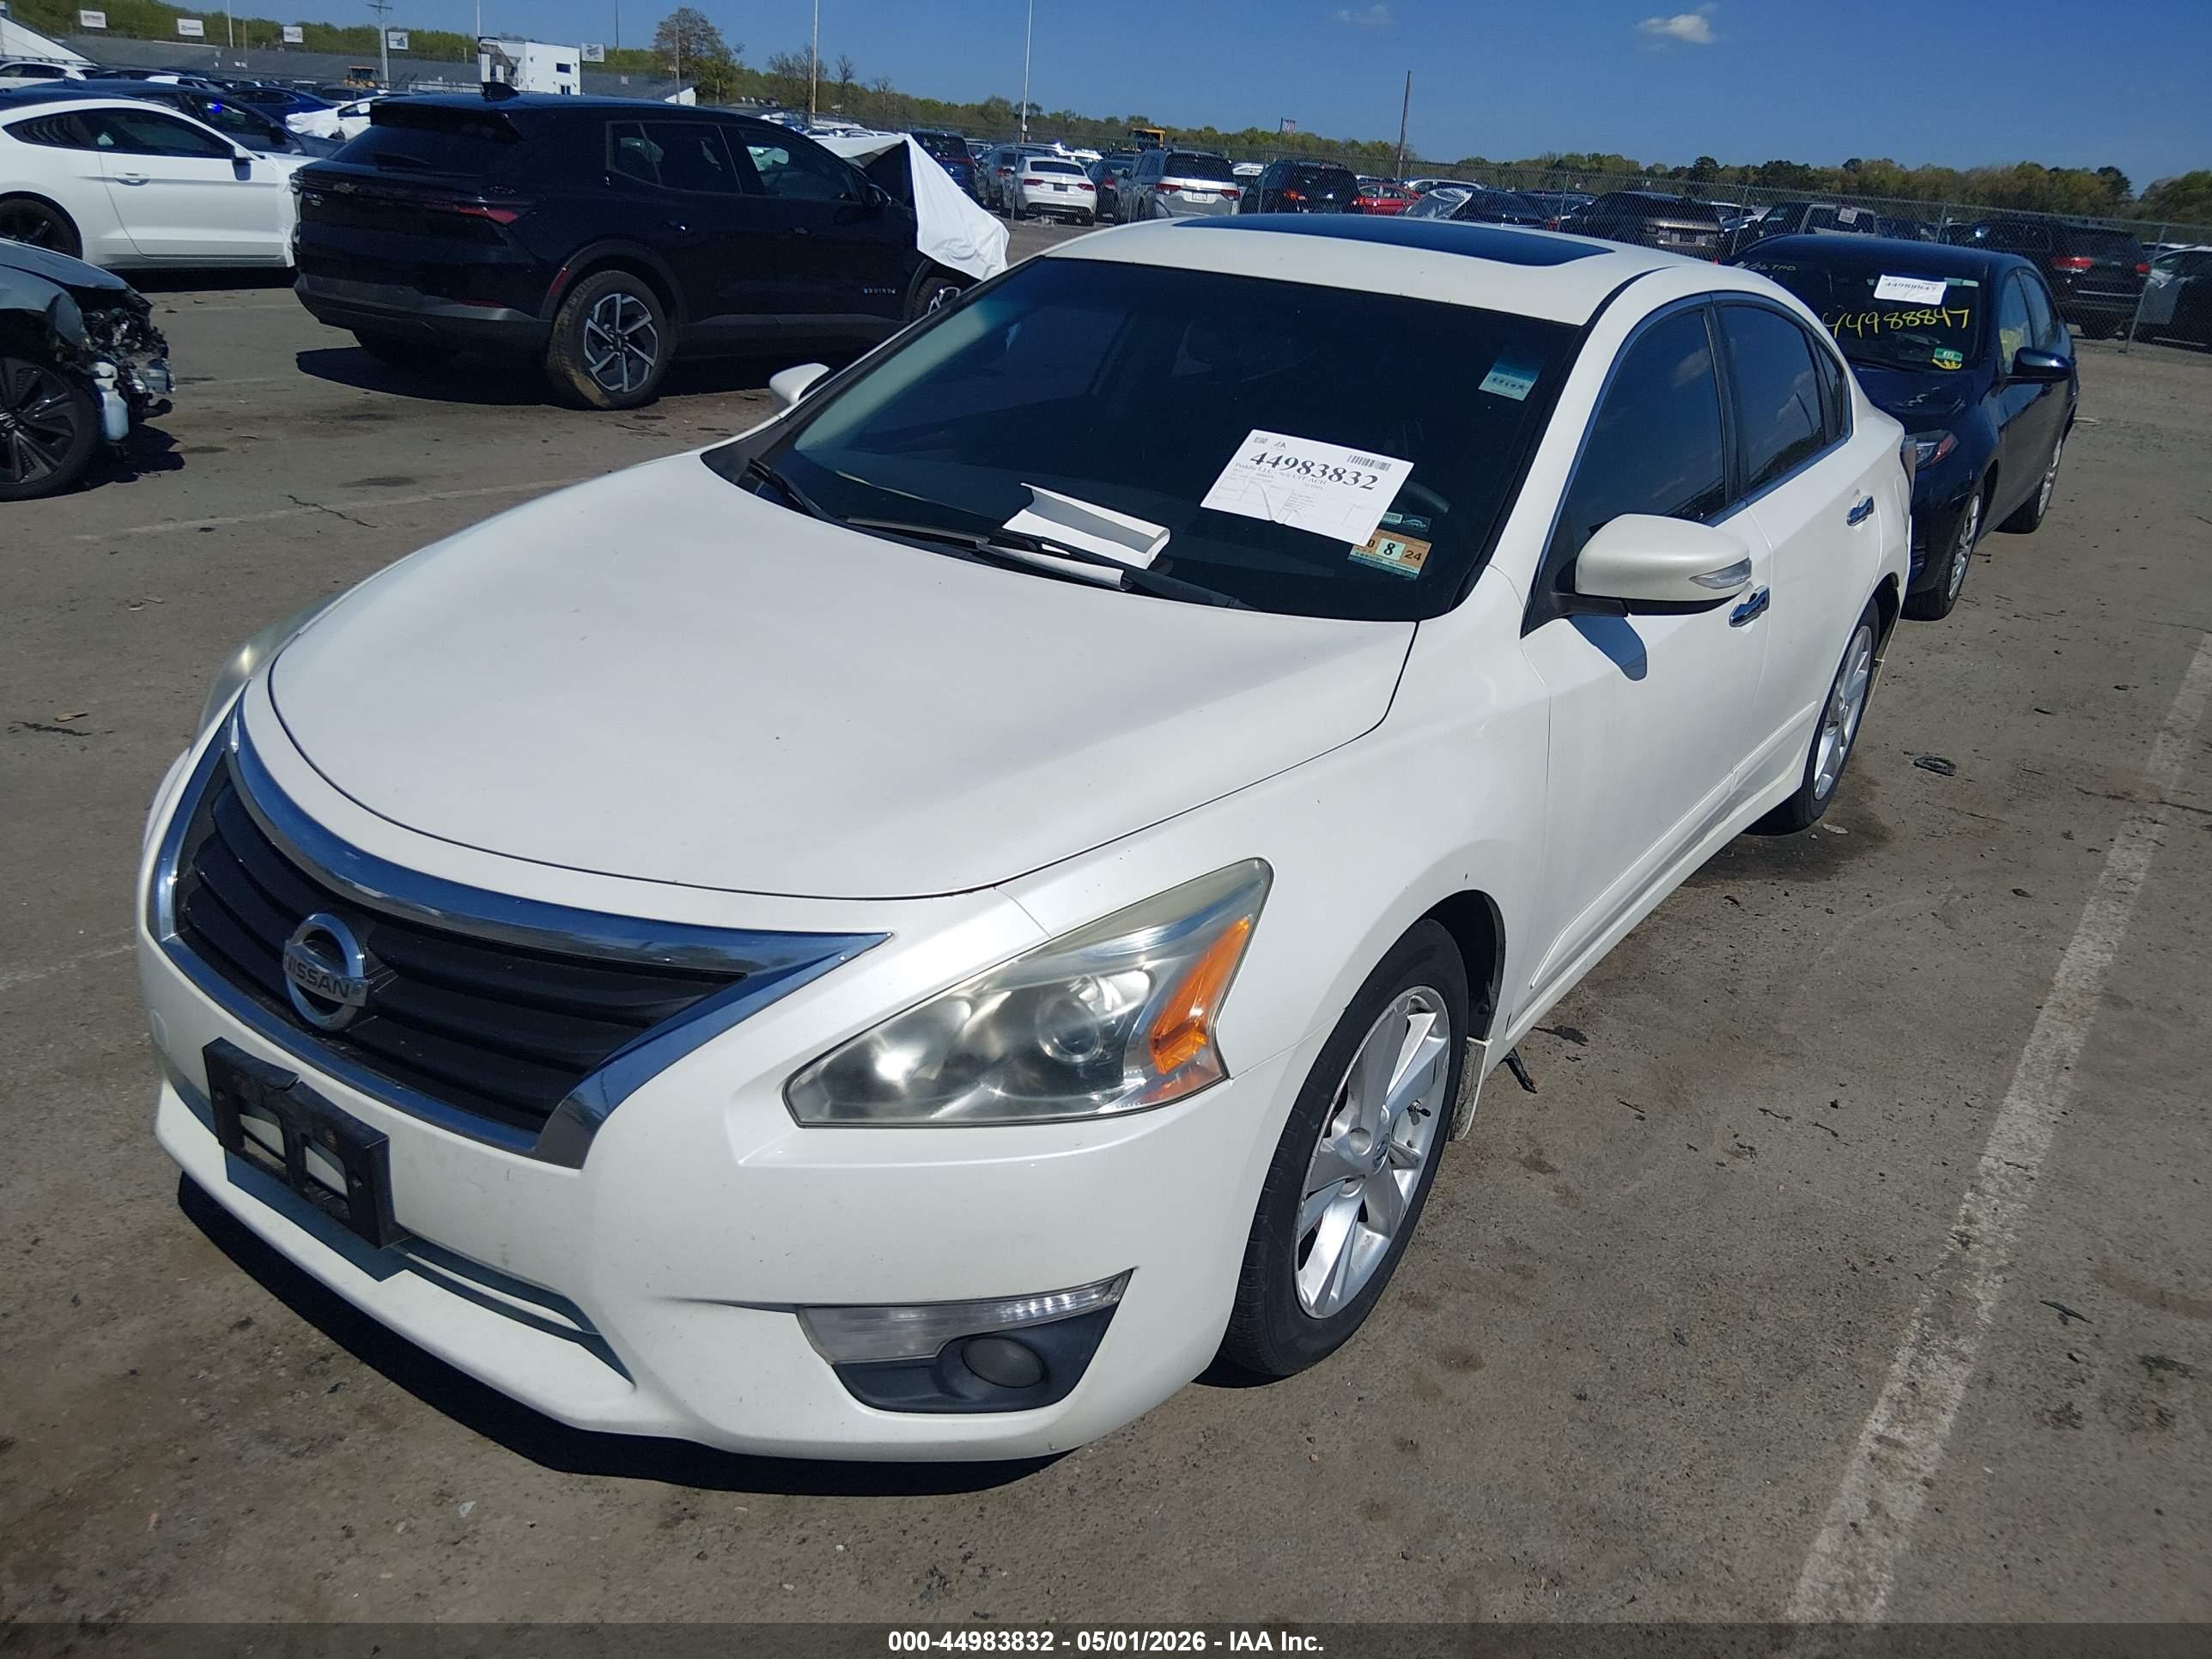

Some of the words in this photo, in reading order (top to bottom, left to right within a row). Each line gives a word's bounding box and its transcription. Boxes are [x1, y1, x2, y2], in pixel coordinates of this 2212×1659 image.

[1822, 307, 1970, 338] 44988847
[1250, 451, 1379, 490] 44983832
[1383, 542, 1395, 556] 8
[1404, 550, 1422, 561] 24
[284, 953, 350, 999] NISSAN
